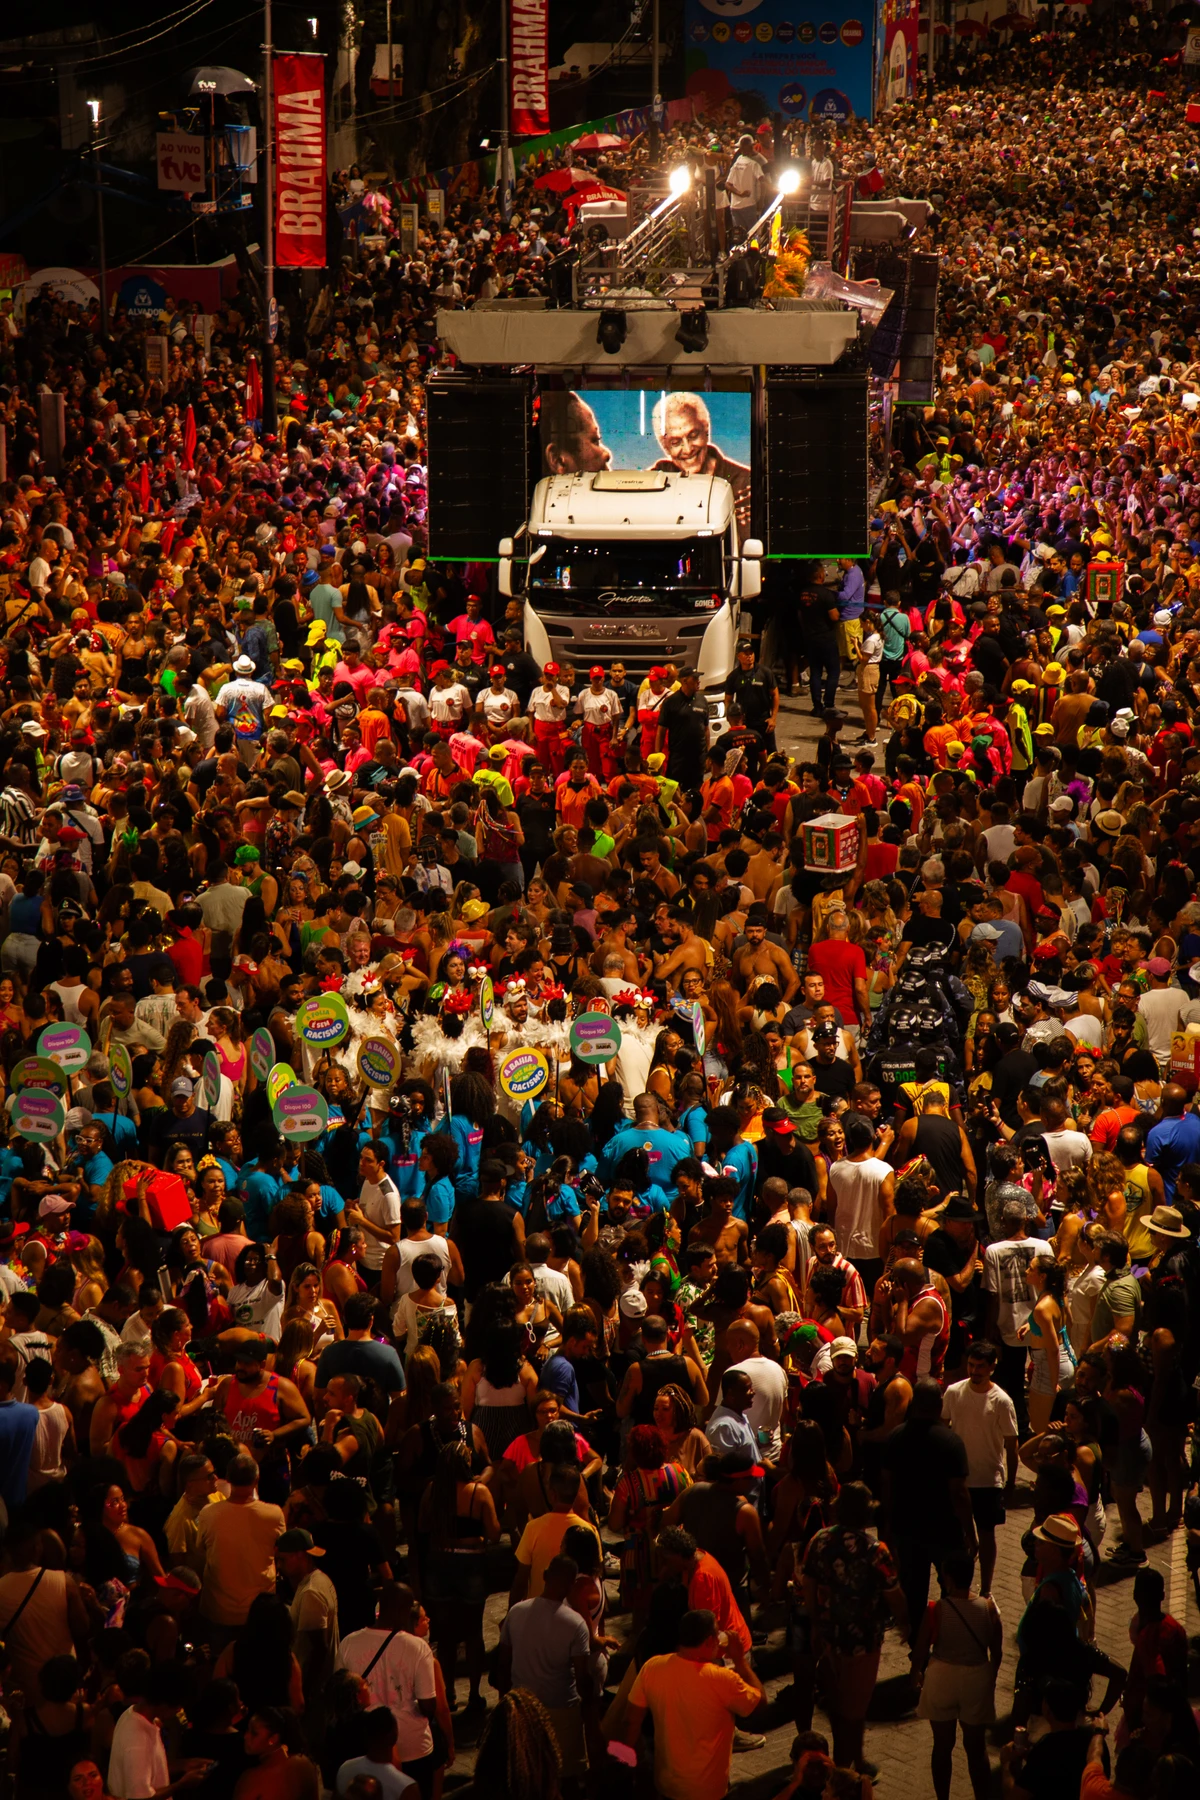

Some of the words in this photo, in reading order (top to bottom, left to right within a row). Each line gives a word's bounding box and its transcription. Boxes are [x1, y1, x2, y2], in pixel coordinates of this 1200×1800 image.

[716, 27, 727, 36] 99
[842, 29, 862, 37] BRAHMA
[513, 0, 546, 110] BRAHMA
[160, 143, 174, 152] AO
[177, 144, 201, 154] VIVO
[161, 156, 201, 181] tve
[278, 90, 322, 235] BRAHMA
[127, 308, 165, 316] ALVADOR
[311, 1009, 330, 1018] FOLIA
[305, 1022, 342, 1039] RACISMO
[311, 1020, 316, 1028] É
[316, 1020, 331, 1029] SEM
[47, 1040, 65, 1048] Disque
[367, 1041, 373, 1050] A
[373, 1042, 394, 1063] BAHIA
[361, 1058, 391, 1082] RACISMO
[503, 1069, 510, 1077] A
[509, 1055, 533, 1071] BAHIA
[511, 1069, 544, 1091] RACISMO
[23, 1103, 40, 1112] Disque
[232, 1410, 259, 1430] Apê
